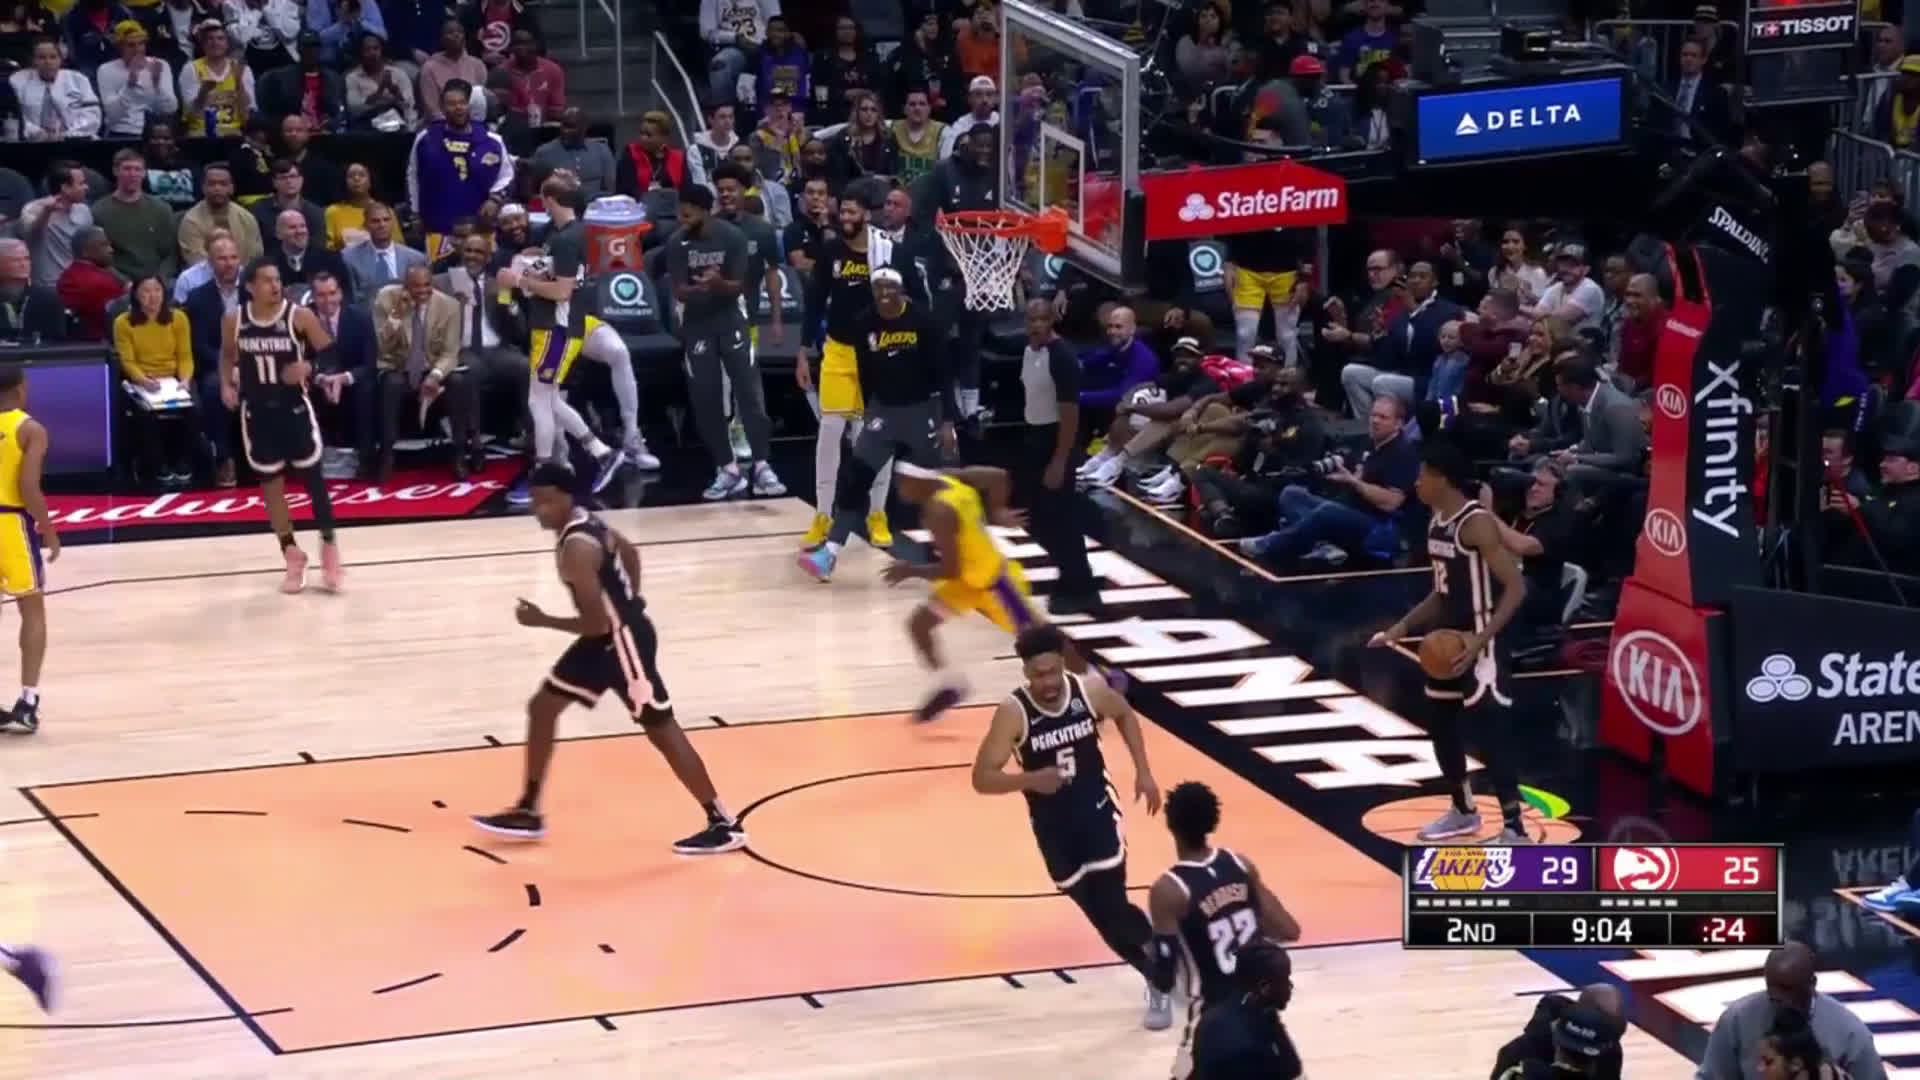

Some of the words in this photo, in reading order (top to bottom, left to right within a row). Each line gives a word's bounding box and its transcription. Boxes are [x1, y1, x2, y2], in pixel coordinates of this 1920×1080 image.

[1781, 15, 1853, 36] TISSOT
[1487, 103, 1581, 131] DELTA
[609, 239, 625, 256] G
[254, 355, 277, 384] 11
[1692, 360, 1752, 538] xfinity
[37, 480, 508, 526] udweiser
[1817, 650, 1920, 698] State
[1030, 718, 1093, 752] PEACHTREE
[1055, 746, 1077, 779] 5
